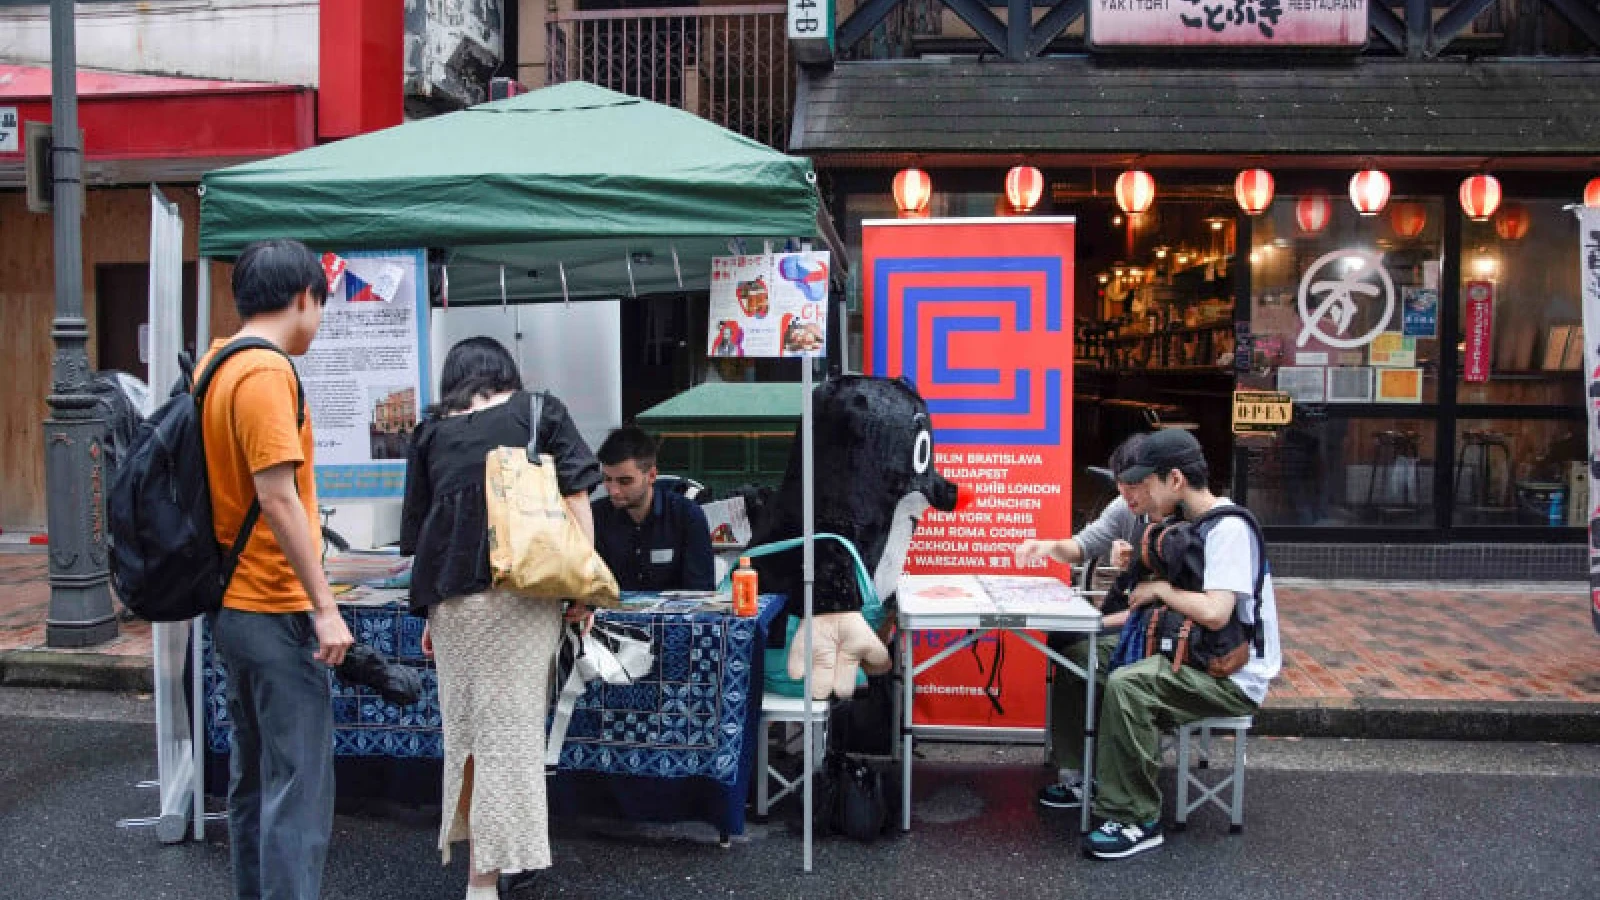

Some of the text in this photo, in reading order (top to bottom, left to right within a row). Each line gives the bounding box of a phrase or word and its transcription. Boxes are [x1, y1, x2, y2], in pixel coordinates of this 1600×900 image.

[1100, 0, 1169, 10] YAKITORI
[1287, 0, 1363, 10] RESTAURANT
[1179, 0, 1283, 38] ことぶき
[934, 453, 1042, 465] RLIN BRATISLAVA
[943, 468, 1008, 479] BUDAPEST
[1007, 484, 1060, 493] LONDON
[976, 495, 1041, 509] MÜNCHEN
[927, 512, 1033, 523] NEW YORK PARIS
[914, 527, 945, 537] DAM
[947, 527, 985, 537] ROMA
[909, 541, 969, 551] OCKHOLM
[915, 556, 985, 566] WARSZAWA
